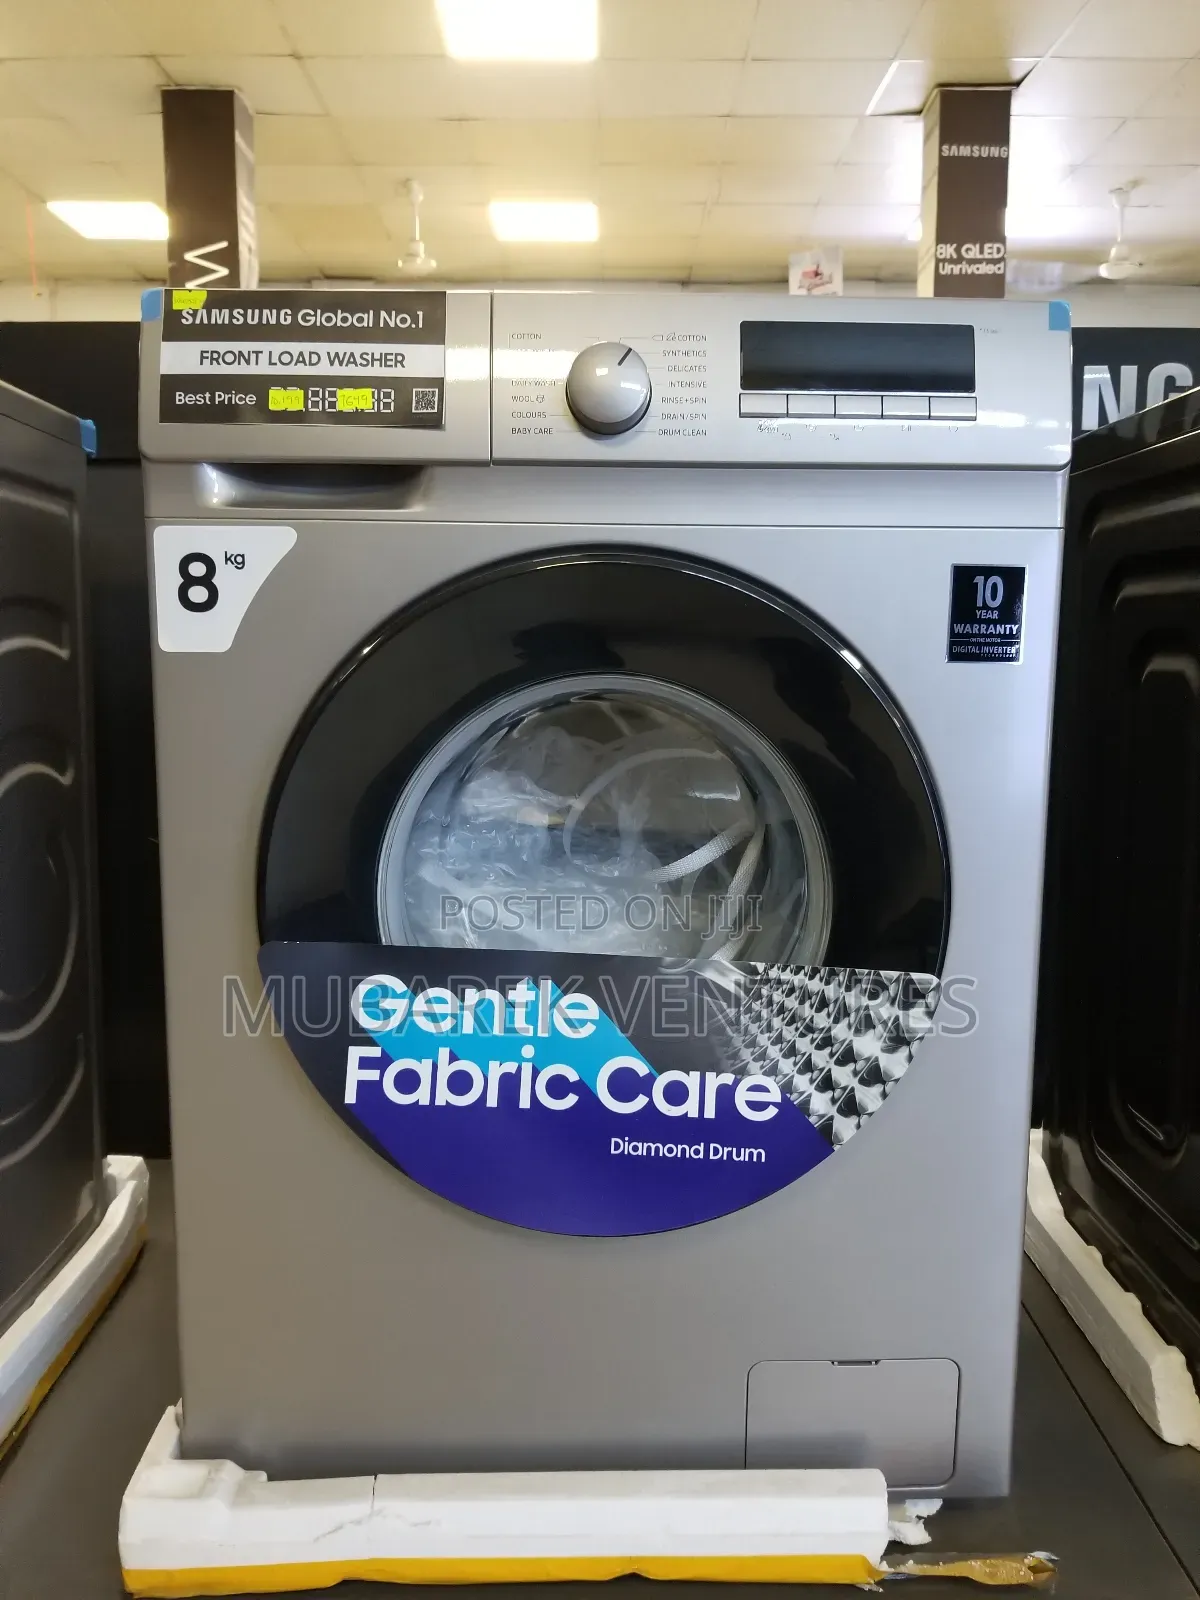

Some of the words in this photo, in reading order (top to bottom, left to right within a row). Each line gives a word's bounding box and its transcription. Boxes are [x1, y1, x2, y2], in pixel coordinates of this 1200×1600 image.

[941, 145, 1009, 158] SAMSUNG
[936, 243, 958, 258] 8K
[939, 261, 1005, 275] Unrivaled
[181, 308, 292, 325] SAMSUNG
[297, 309, 374, 328] Global
[379, 311, 424, 329] No.1
[511, 332, 542, 340] COTTON
[677, 334, 707, 342] COTTON
[199, 350, 264, 367] FRONT
[268, 351, 322, 368] LOAD
[327, 352, 406, 369] WASHER
[667, 365, 707, 373] DELICATES
[668, 380, 707, 388] INTENSIVE
[175, 391, 211, 405] Best
[215, 391, 257, 406] Price
[511, 395, 535, 403] WOOL
[511, 411, 547, 419] COLOURS
[511, 427, 532, 435] BABY
[533, 427, 554, 435] CARE
[658, 428, 681, 436] DRUM
[682, 428, 707, 437] CLEAN
[177, 552, 219, 613] 8
[224, 551, 246, 570] kg
[972, 575, 1004, 608] 10
[975, 610, 999, 619] YEAR
[953, 624, 1020, 634] WARRANTY
[952, 645, 979, 653] DIGITAL
[980, 645, 1016, 654] INVERTER
[350, 973, 600, 1039] Gentle
[344, 1044, 580, 1111] Fabric
[596, 1055, 782, 1122] Care
[610, 1136, 704, 1160] Diamond
[709, 1142, 766, 1163] Drum
